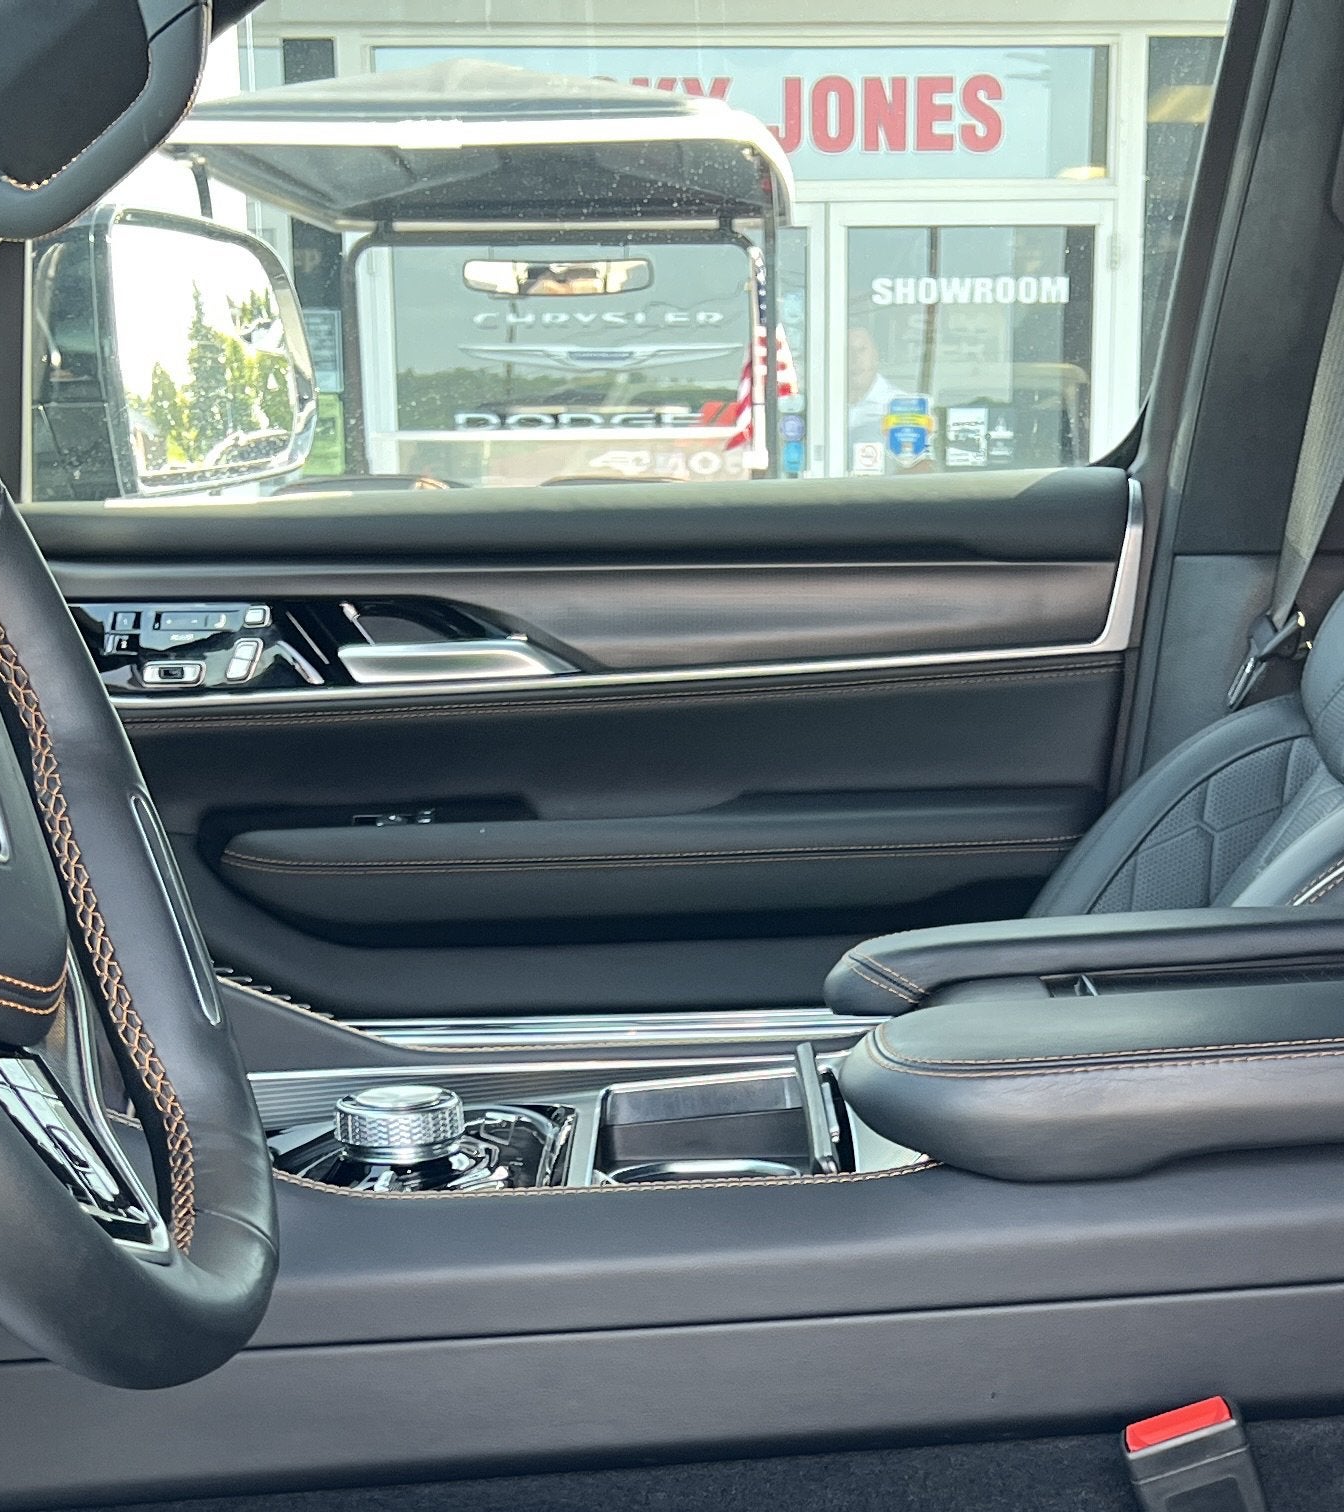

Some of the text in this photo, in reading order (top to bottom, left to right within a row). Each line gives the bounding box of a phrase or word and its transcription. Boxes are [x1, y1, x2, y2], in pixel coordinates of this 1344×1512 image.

[767, 74, 1004, 153] JONES
[871, 276, 1071, 304] SHOWROOM
[454, 412, 705, 429] DODGE
